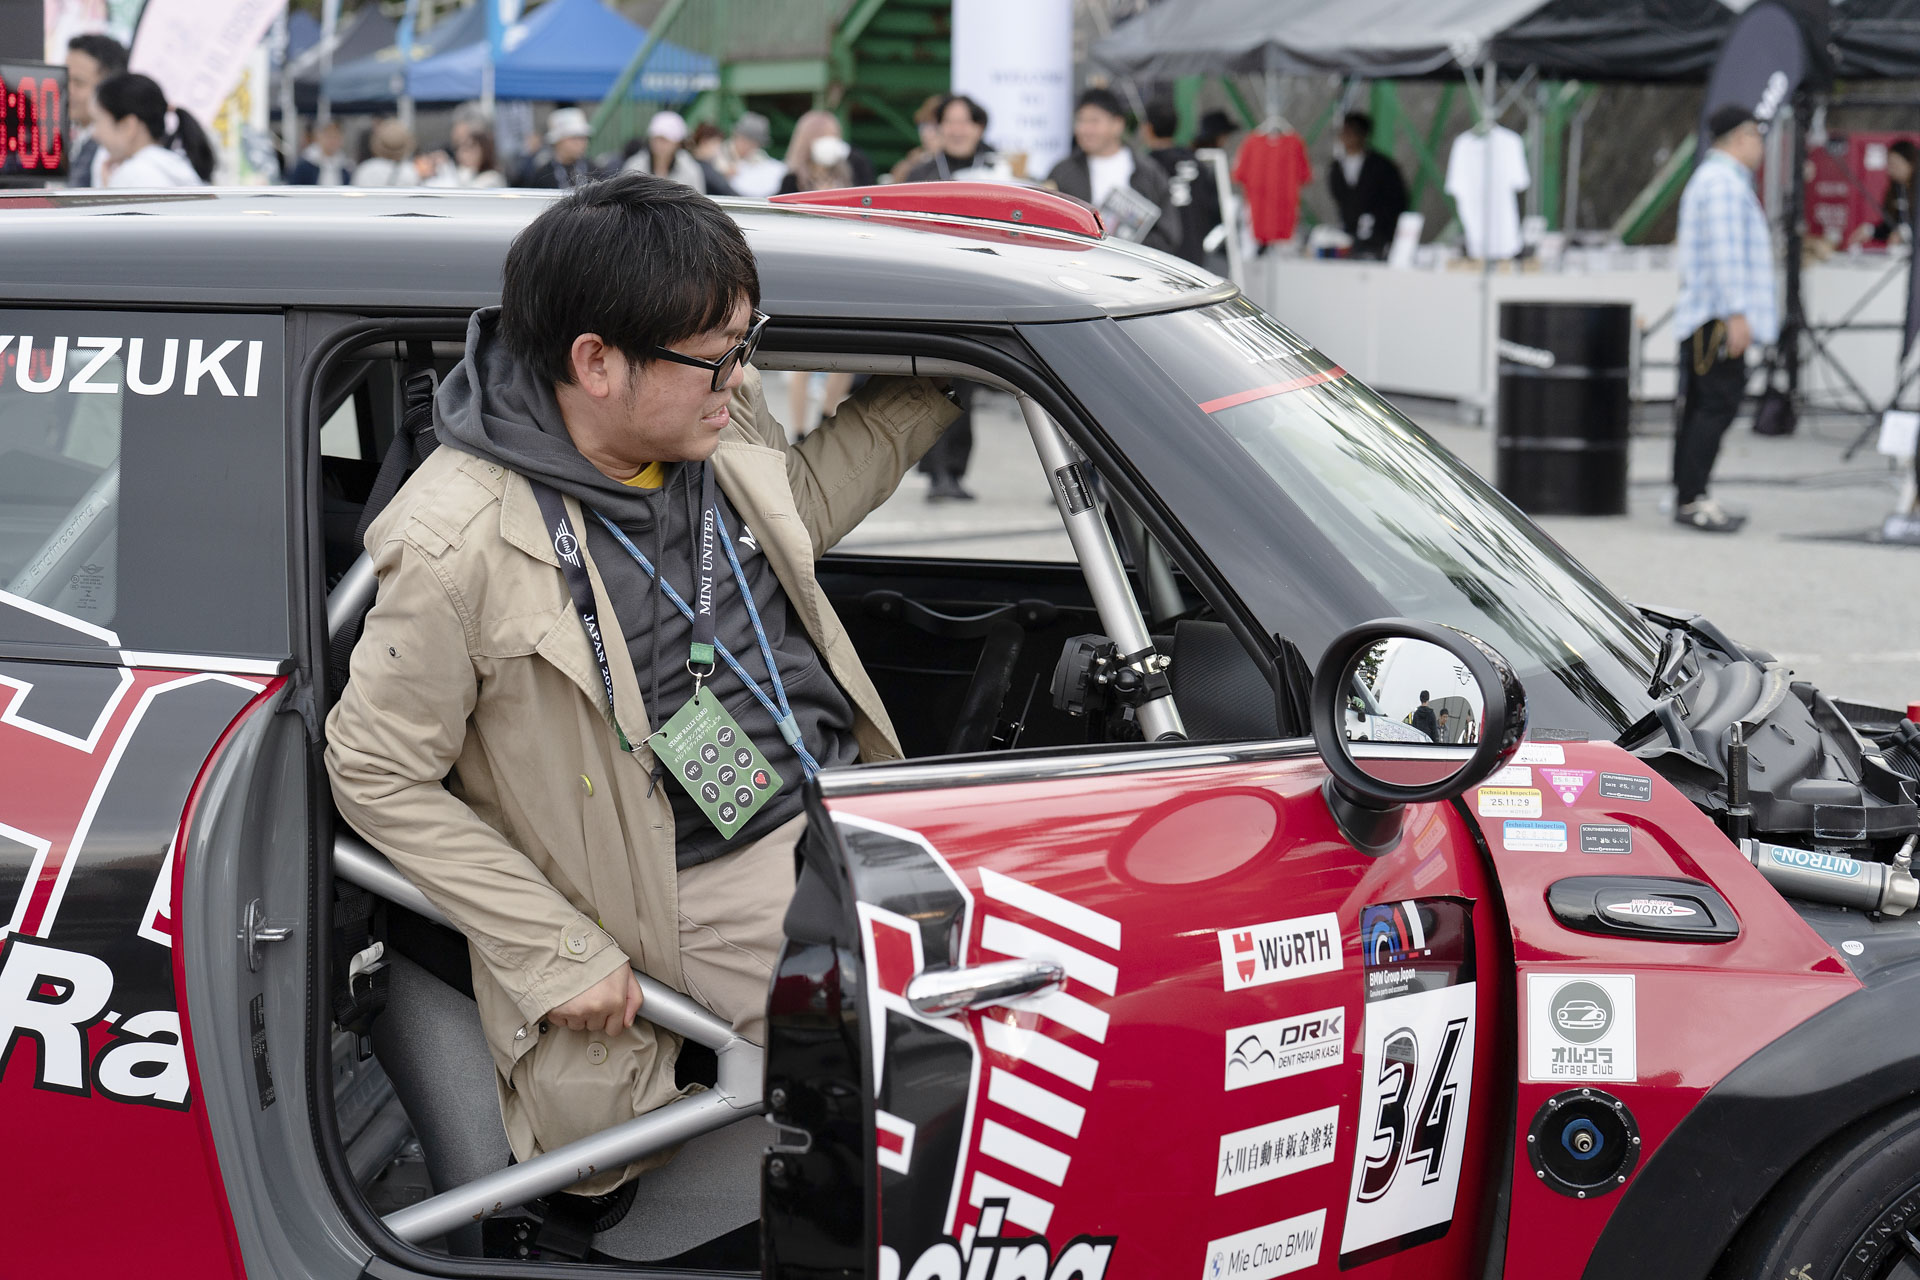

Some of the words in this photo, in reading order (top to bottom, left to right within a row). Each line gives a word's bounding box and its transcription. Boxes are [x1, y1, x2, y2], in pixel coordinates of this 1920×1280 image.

[0, 75, 62, 169] :00
[0, 335, 263, 397] UZUKI
[28, 503, 96, 577] Engineering
[561, 535, 572, 554] MINI
[700, 576, 713, 616] MINI
[583, 613, 606, 663] JAPAN
[668, 732, 684, 749] STAMP
[682, 718, 697, 735] RALLY
[695, 707, 709, 723] CARD
[687, 764, 699, 776] WE
[1490, 798, 1530, 807] 25.11.29
[1505, 821, 1533, 829] Technical
[1534, 822, 1565, 830] Inspection
[1631, 904, 1674, 915] WORKS
[1369, 970, 1384, 986] BMW
[1385, 969, 1400, 985] Group
[1400, 967, 1416, 982] Japan
[1280, 1015, 1342, 1046] DRK
[1278, 1054, 1296, 1069] DENT
[1297, 1048, 1321, 1065] REPAIR
[1321, 1044, 1341, 1059] KASAI
[1551, 1063, 1588, 1076] Garage
[1592, 1064, 1613, 1075] Club
[1552, 1046, 1613, 1064] オルクラ
[1356, 1017, 1468, 1204] 34
[1221, 1122, 1334, 1179] 大川自動車鈑金塗装
[1856, 1193, 1920, 1263] DYNAM
[1228, 1249, 1250, 1276] Mie
[1253, 1242, 1283, 1268] Chuo
[1285, 1226, 1318, 1257] BMW
